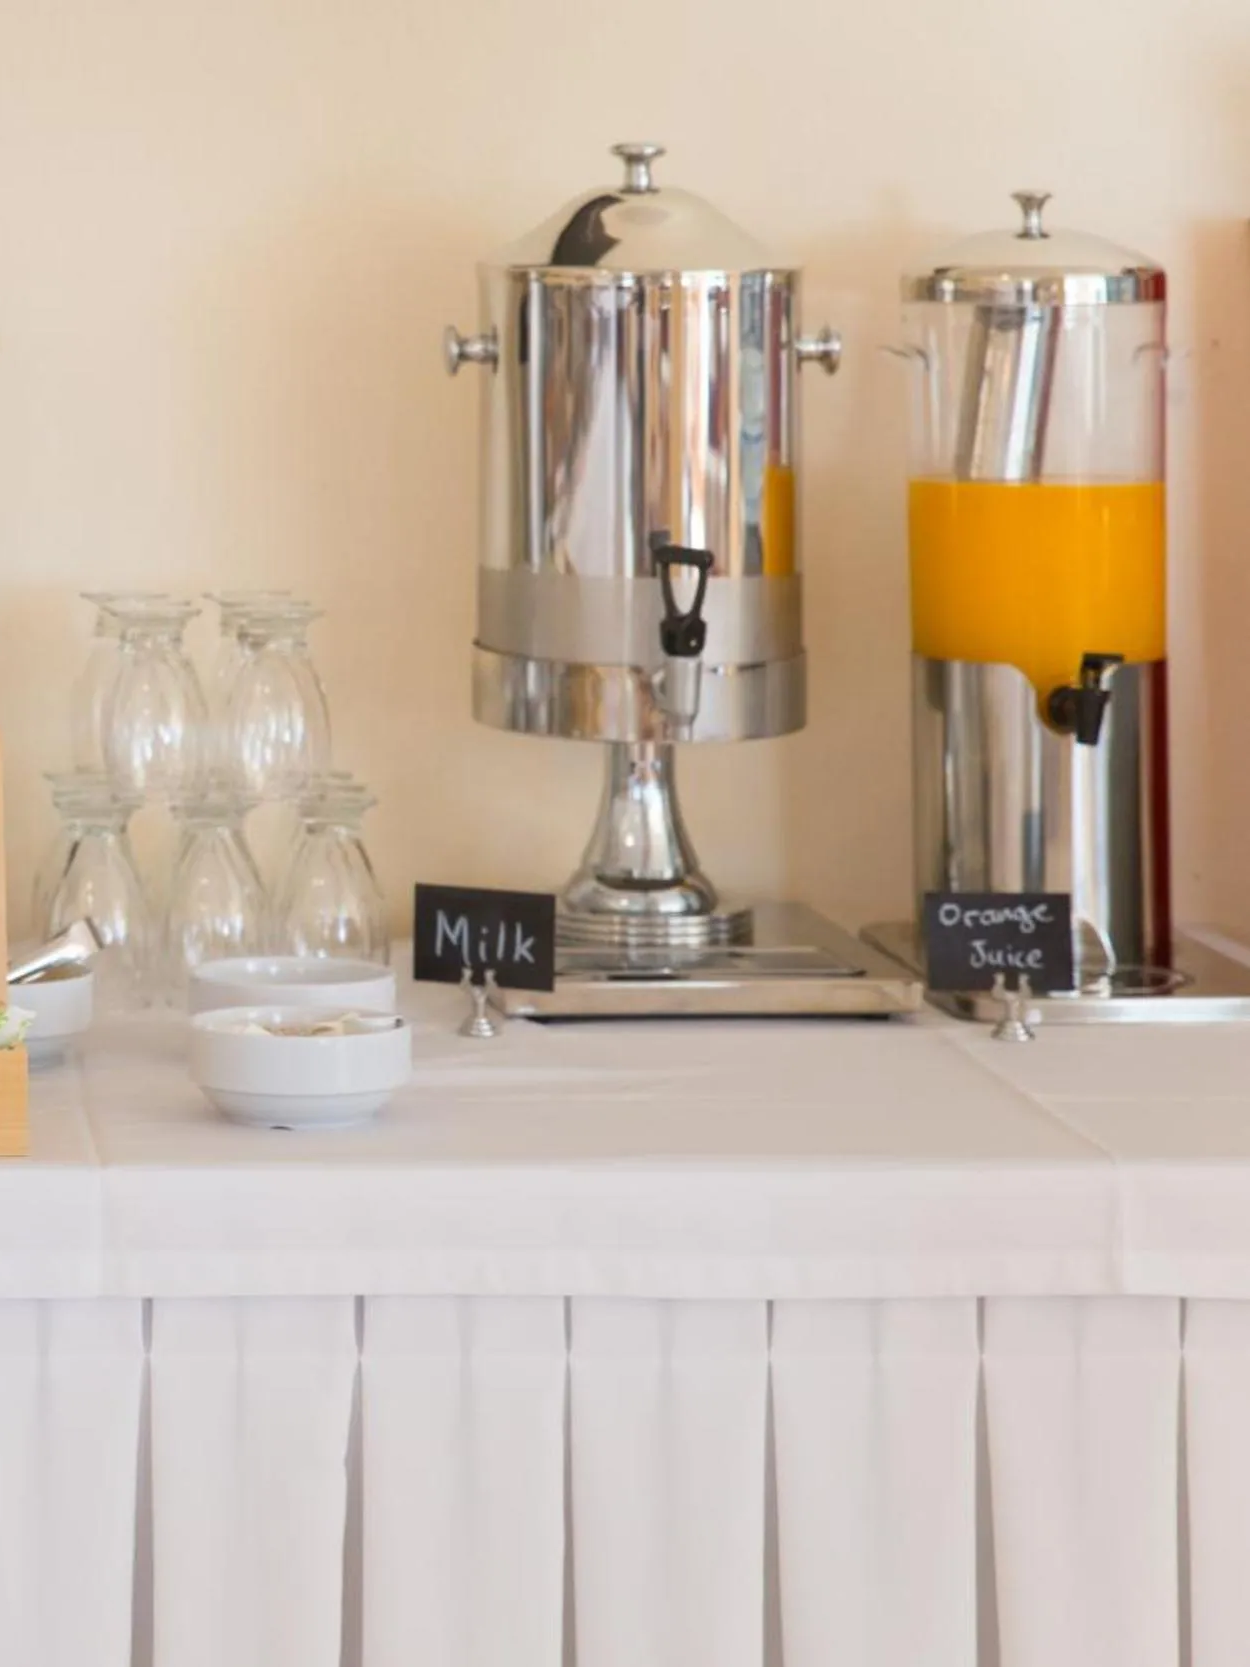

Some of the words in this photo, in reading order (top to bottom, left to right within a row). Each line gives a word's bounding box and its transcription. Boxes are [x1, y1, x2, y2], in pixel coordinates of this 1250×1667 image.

[938, 902, 1054, 934] Orange
[435, 909, 536, 967] Milk
[969, 939, 1044, 969] Juice
